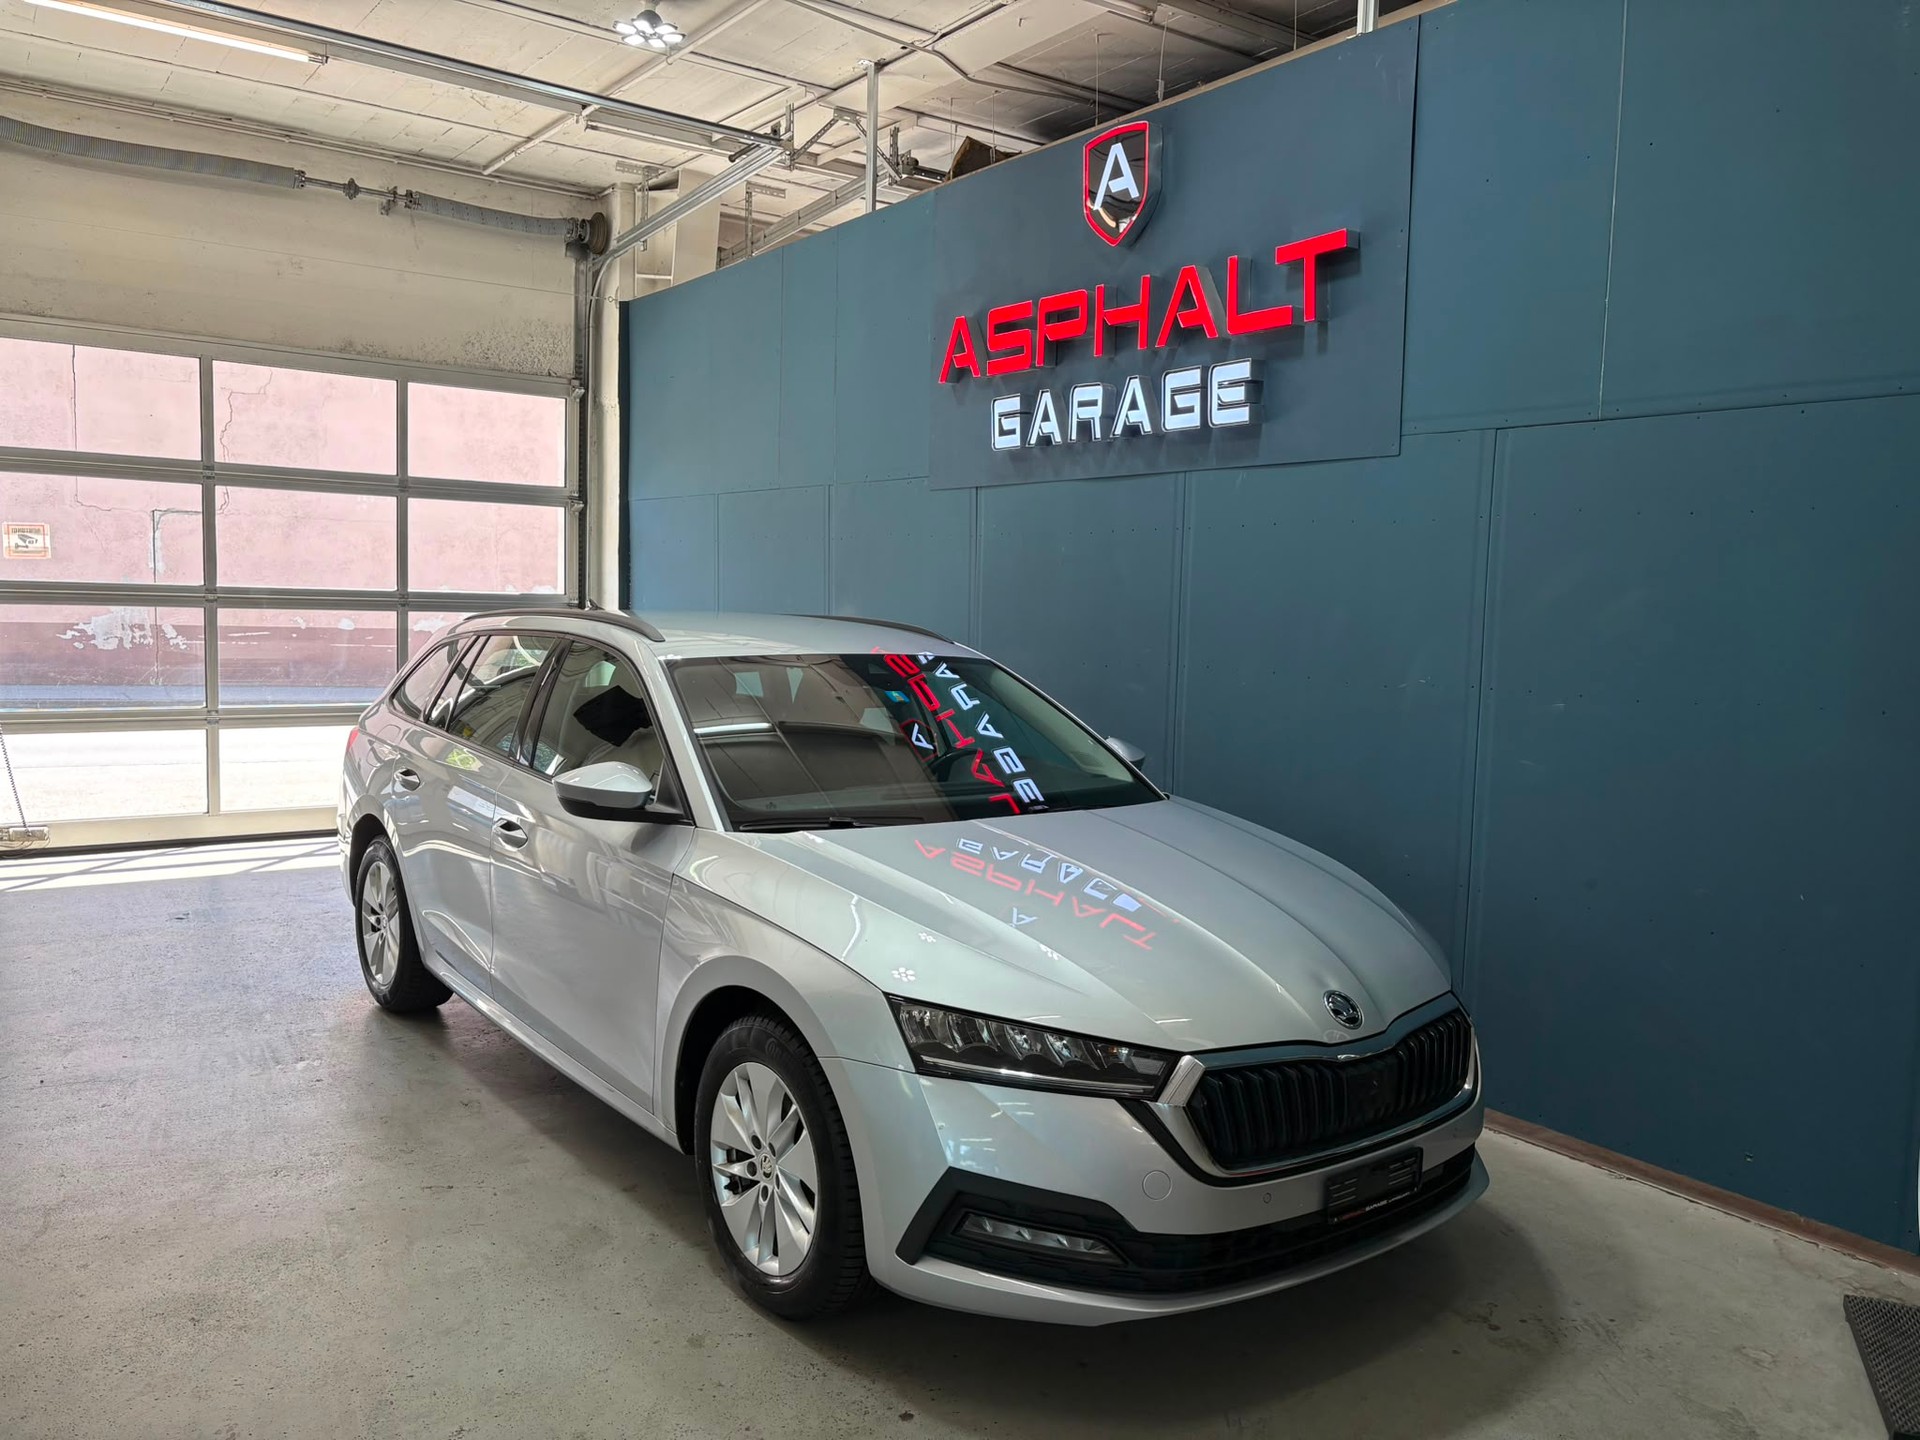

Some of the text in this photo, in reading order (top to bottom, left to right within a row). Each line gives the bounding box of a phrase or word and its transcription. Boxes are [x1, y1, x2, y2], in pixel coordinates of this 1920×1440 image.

[1093, 142, 1140, 211] A
[938, 227, 1348, 385] ASPHALT
[990, 357, 1253, 452] GARAGE
